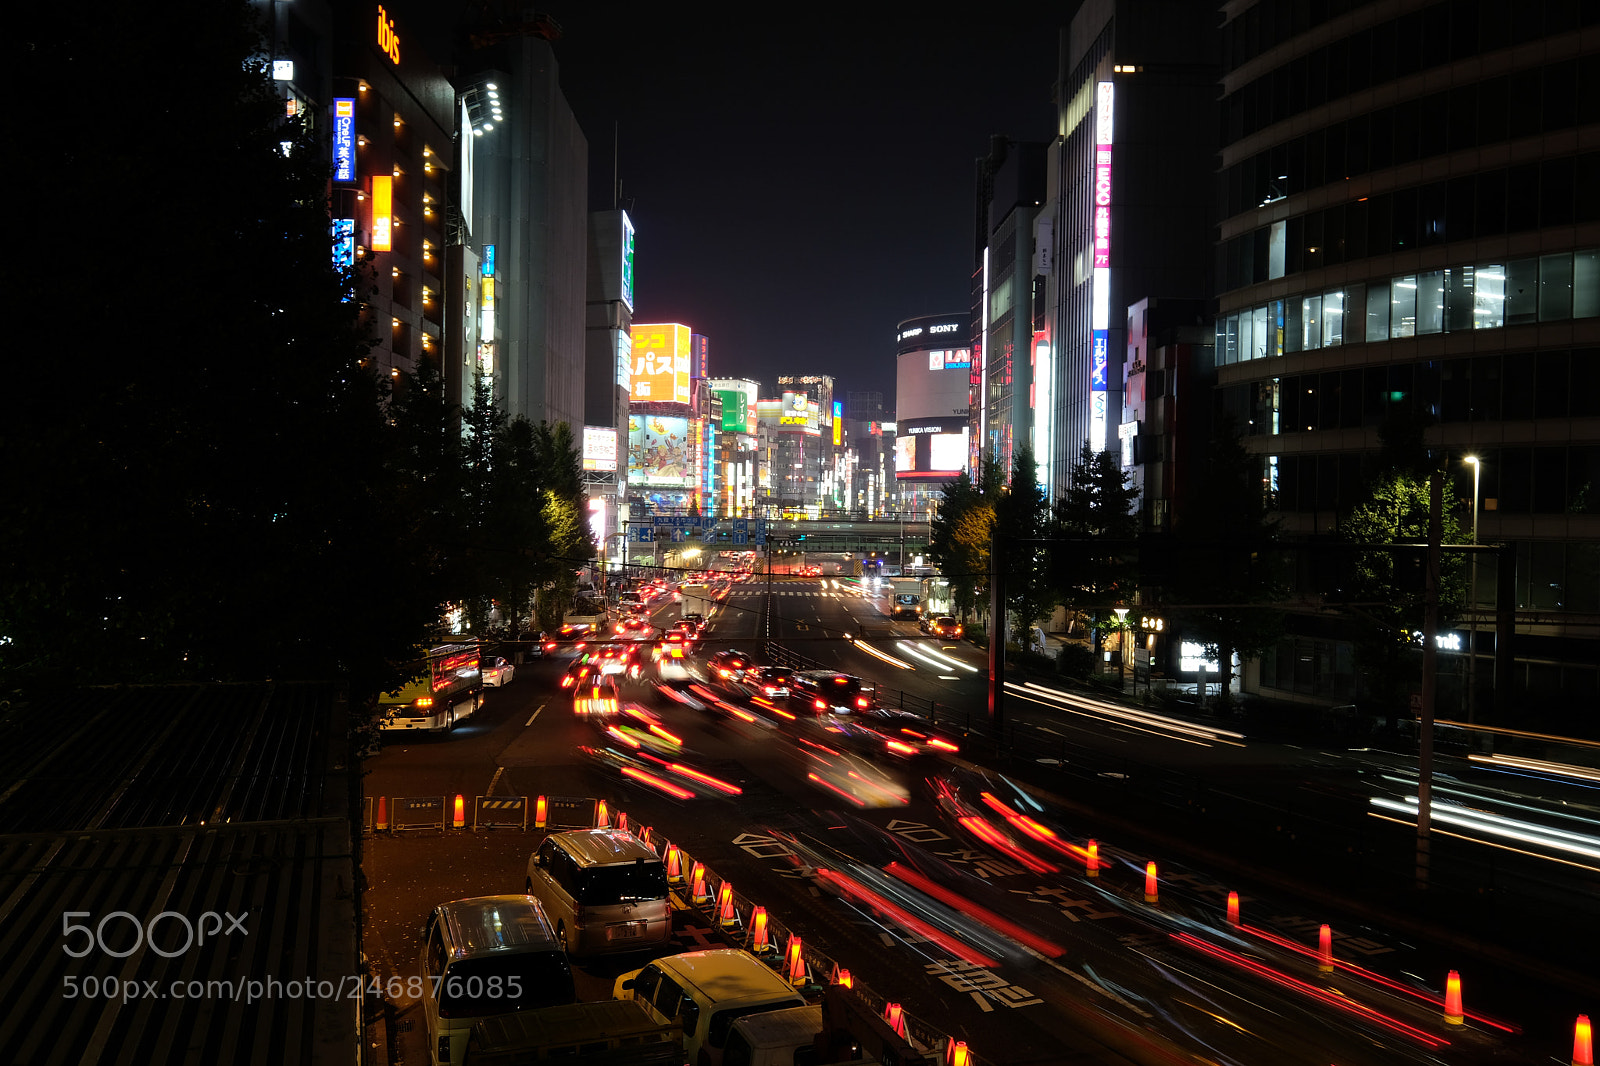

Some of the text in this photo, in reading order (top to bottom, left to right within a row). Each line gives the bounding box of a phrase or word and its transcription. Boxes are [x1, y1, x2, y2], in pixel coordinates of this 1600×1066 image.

[377, 5, 400, 65] ibis
[1096, 168, 1111, 206] ECC
[1095, 254, 1109, 265] 7F
[902, 323, 959, 339] SHARP SONY
[630, 351, 674, 376] パス
